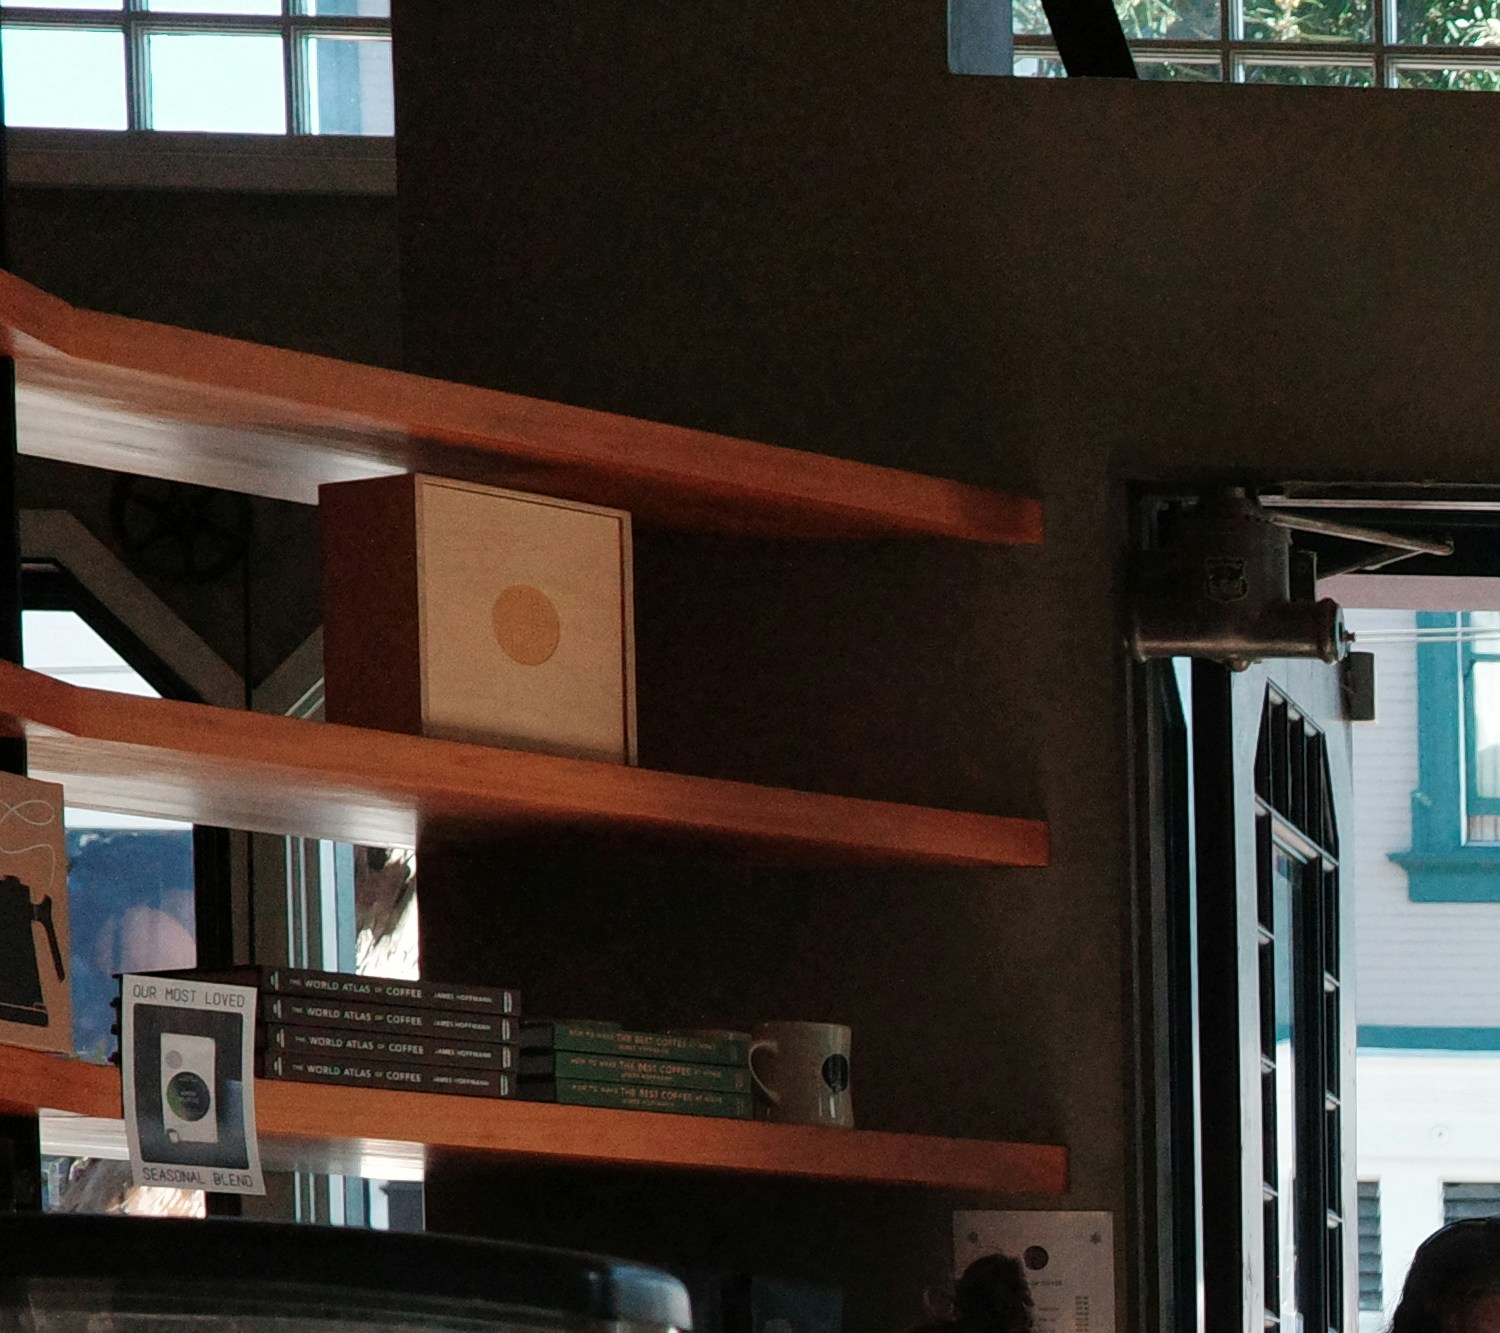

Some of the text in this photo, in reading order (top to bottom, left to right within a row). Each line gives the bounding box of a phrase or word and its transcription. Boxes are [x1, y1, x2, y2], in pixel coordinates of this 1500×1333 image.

[133, 984, 246, 1008] OUR MOST LOVED
[304, 980, 339, 991] WORLD
[342, 983, 371, 994] ATLAS
[386, 987, 423, 999] COFFEE
[306, 1008, 340, 1019] WORLD
[343, 1011, 371, 1022] ATLAS
[386, 1014, 422, 1026] COFFEE
[309, 1036, 343, 1048] WORLD
[346, 1040, 374, 1050] ATLAS
[388, 1043, 424, 1055] COFFEE
[307, 1064, 341, 1076] WORLD
[343, 1068, 371, 1078] ATLAS
[386, 1071, 422, 1083] COFFEE
[142, 1168, 254, 1187] SEASONAL BLEND
